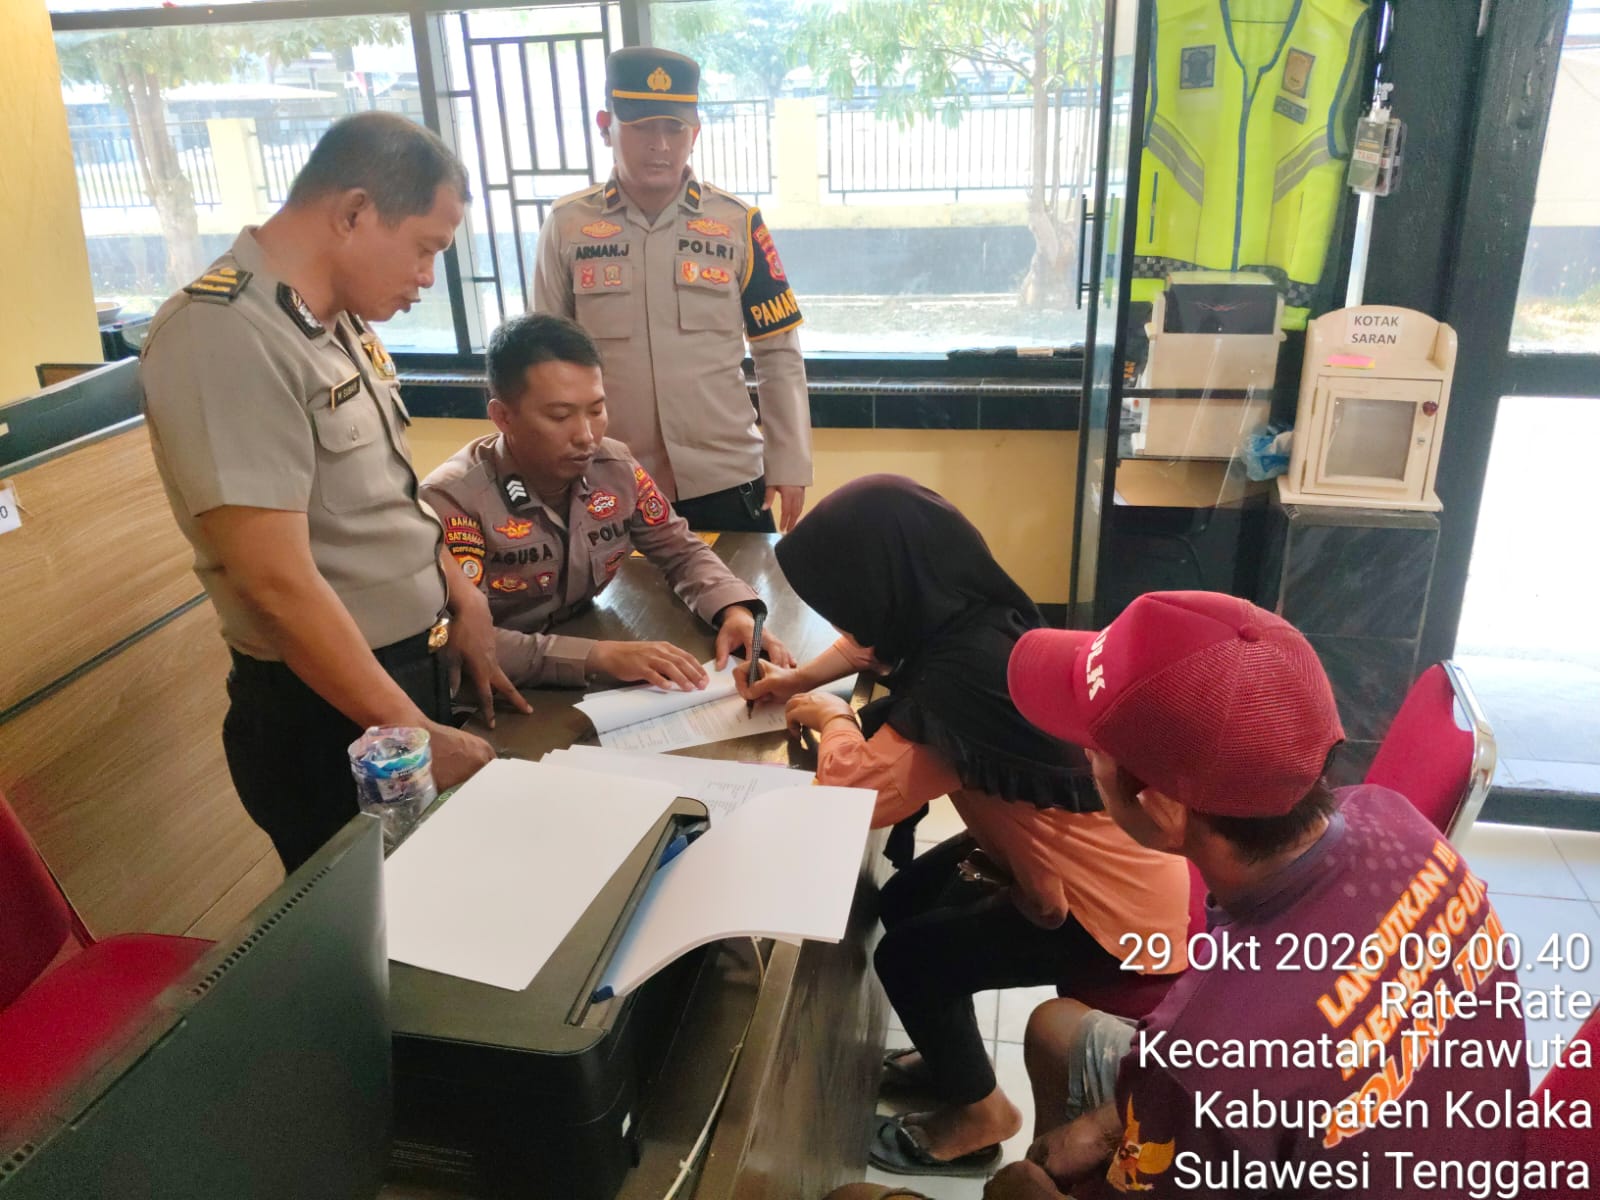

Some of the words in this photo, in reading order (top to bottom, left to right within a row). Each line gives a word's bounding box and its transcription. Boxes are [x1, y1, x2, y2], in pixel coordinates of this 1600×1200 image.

[678, 239, 734, 260] POLRI
[1353, 315, 1400, 327] KOTAK
[1351, 332, 1397, 345] SARAN
